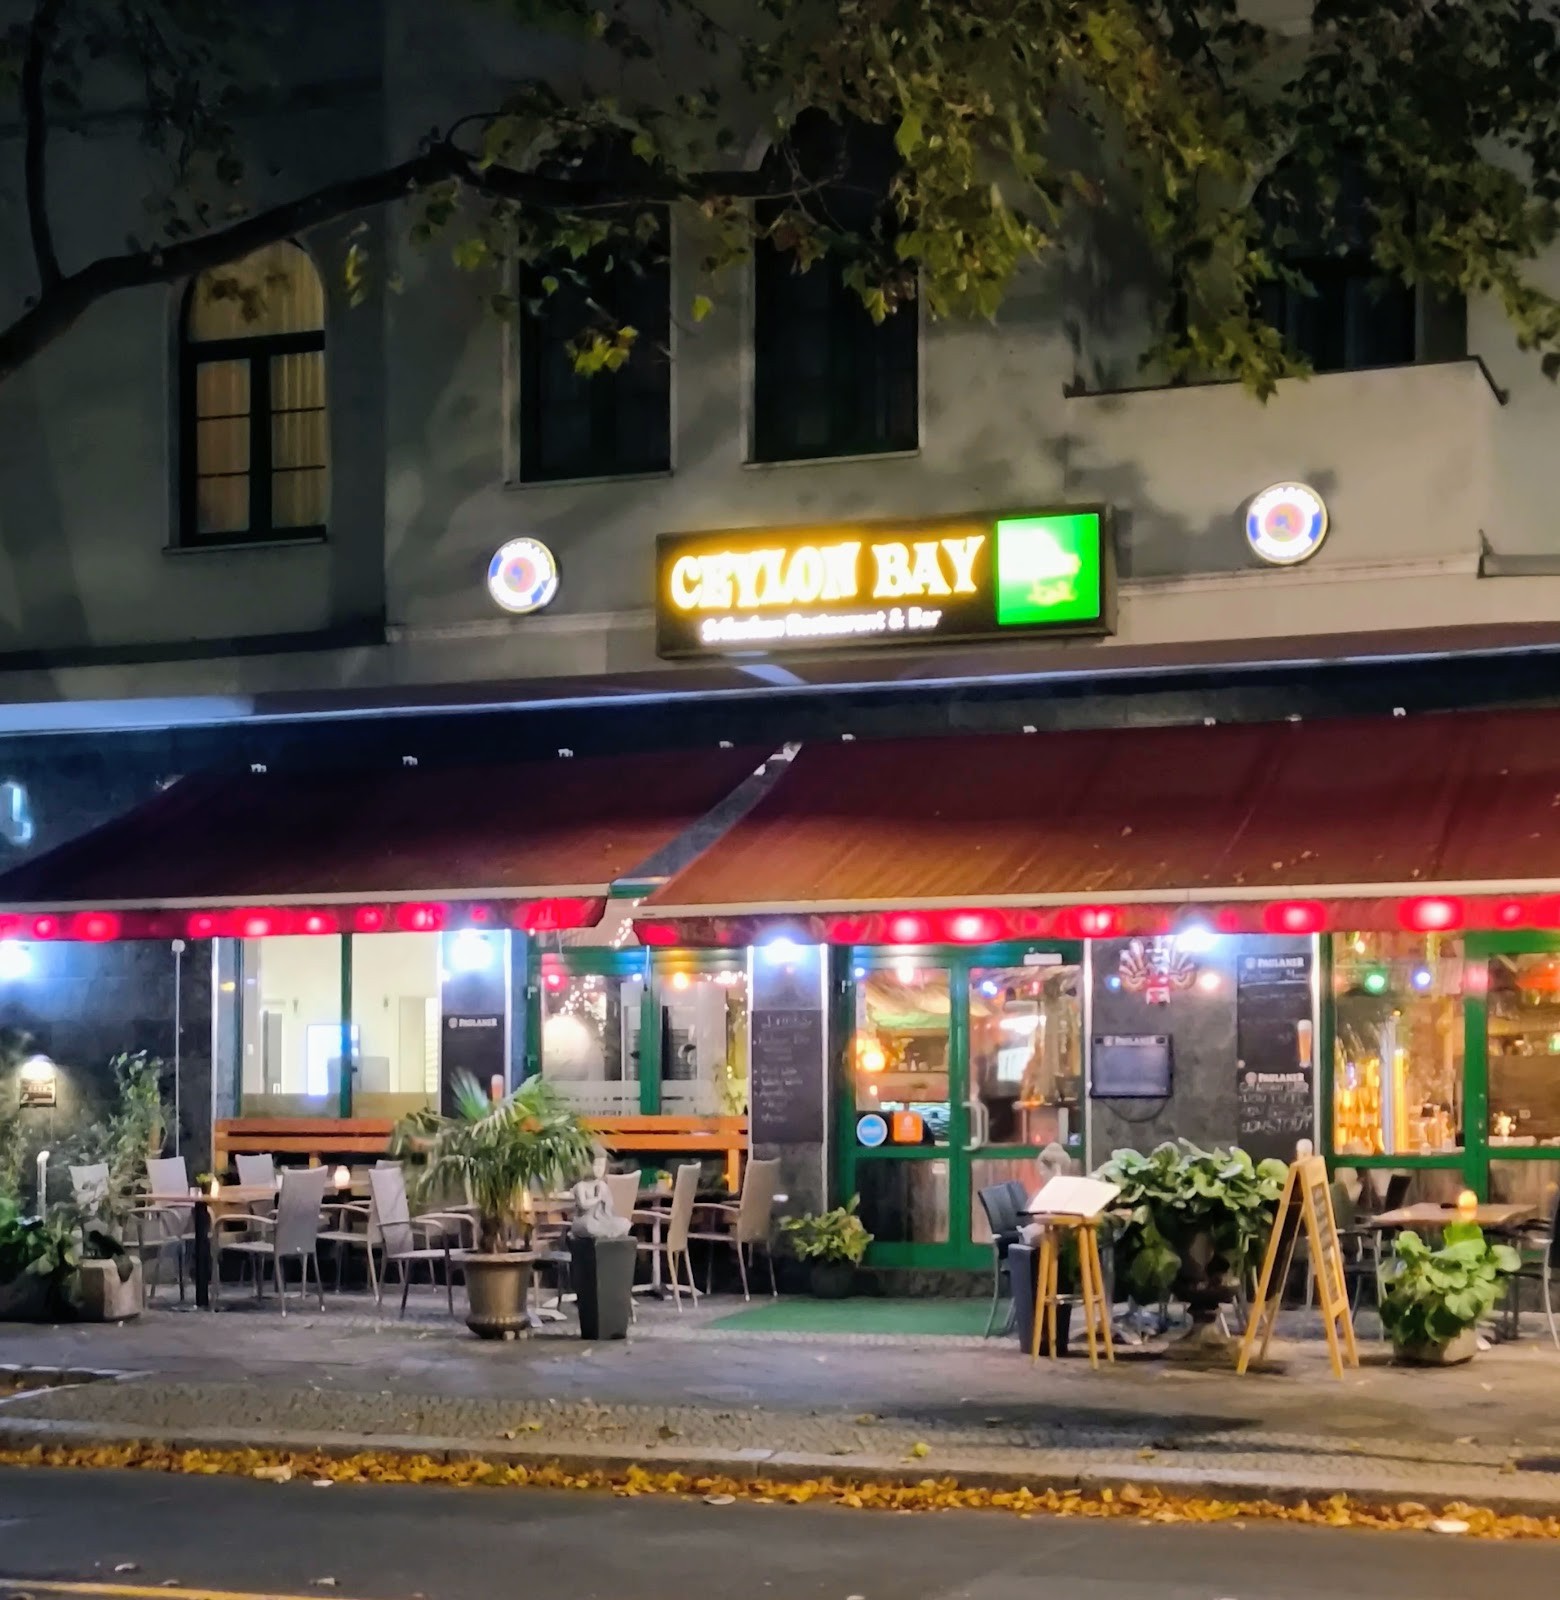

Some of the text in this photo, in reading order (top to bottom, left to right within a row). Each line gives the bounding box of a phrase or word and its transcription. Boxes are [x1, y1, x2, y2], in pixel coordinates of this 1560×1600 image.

[671, 535, 985, 607] CEYLON BAY
[888, 607, 905, 629] &
[908, 606, 942, 627] Bar
